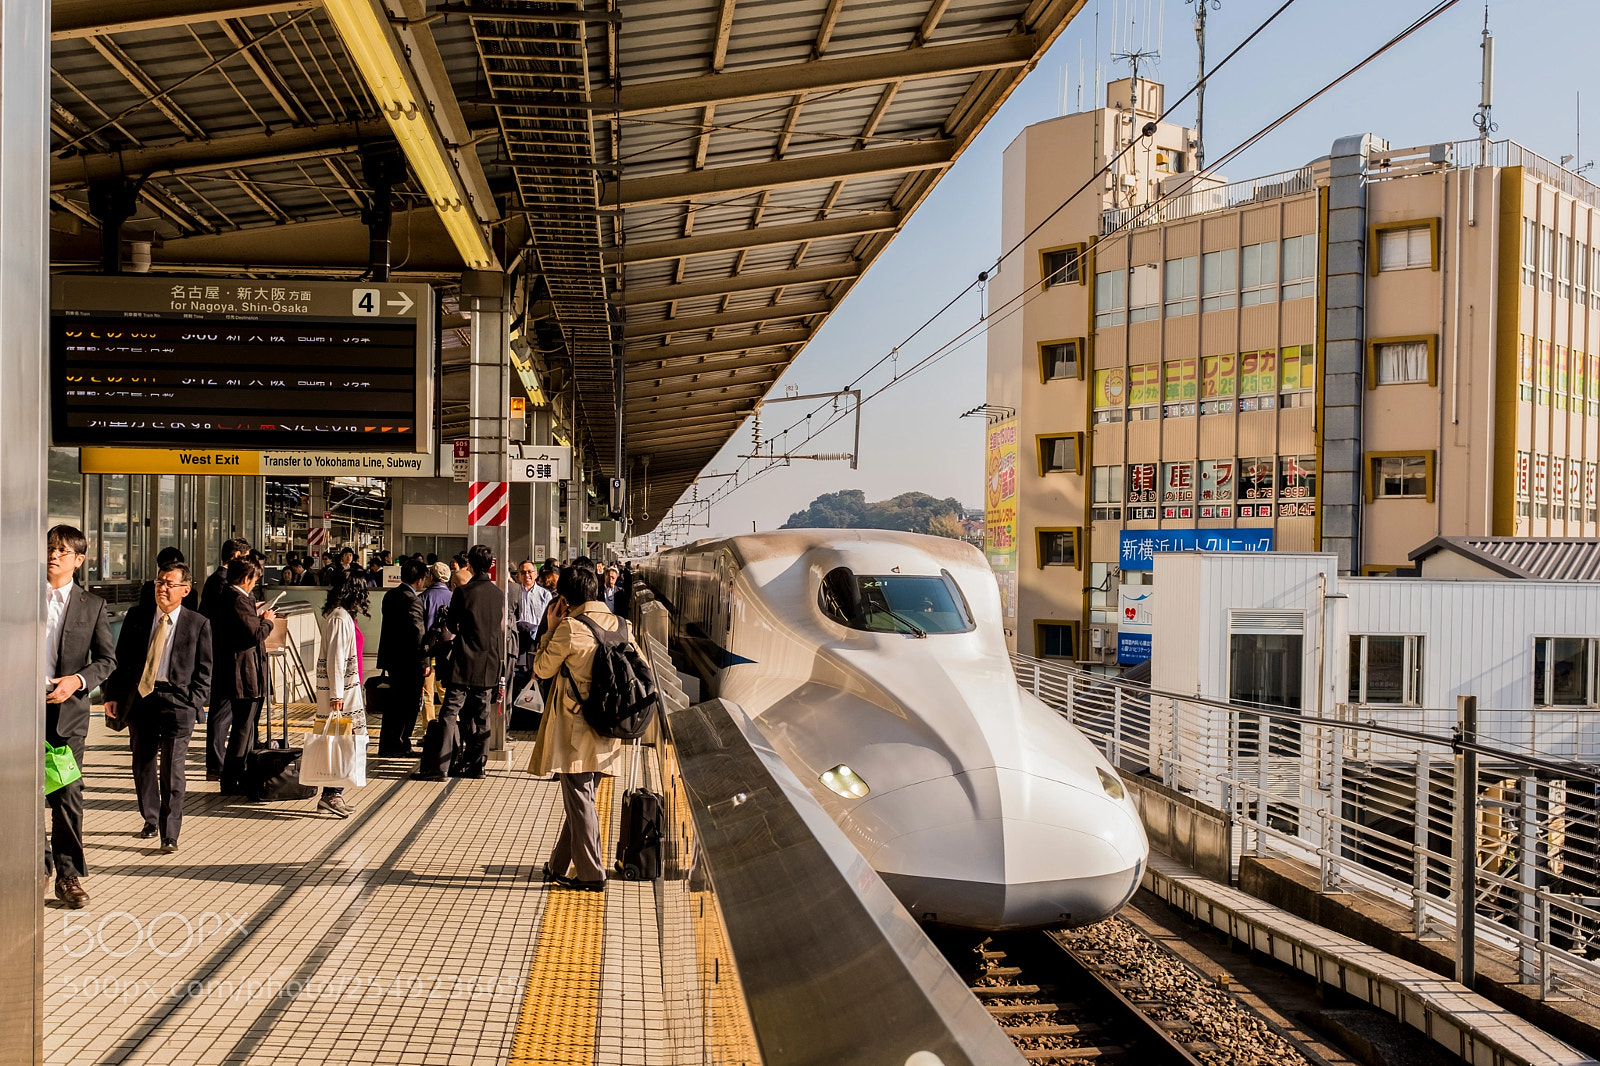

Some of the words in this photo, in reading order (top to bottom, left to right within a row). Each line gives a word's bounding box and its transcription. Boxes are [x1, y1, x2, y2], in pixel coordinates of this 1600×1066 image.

[170, 301, 187, 311] for
[191, 301, 238, 313] Nagoya,
[358, 292, 375, 313] 4
[179, 453, 211, 465] West
[215, 454, 240, 465] Exit
[263, 455, 300, 467] Transfer
[303, 457, 313, 467] to
[314, 456, 360, 468] Yokohama
[362, 456, 385, 469] Line,
[386, 457, 422, 471] Subway
[614, 480, 620, 488] 6
